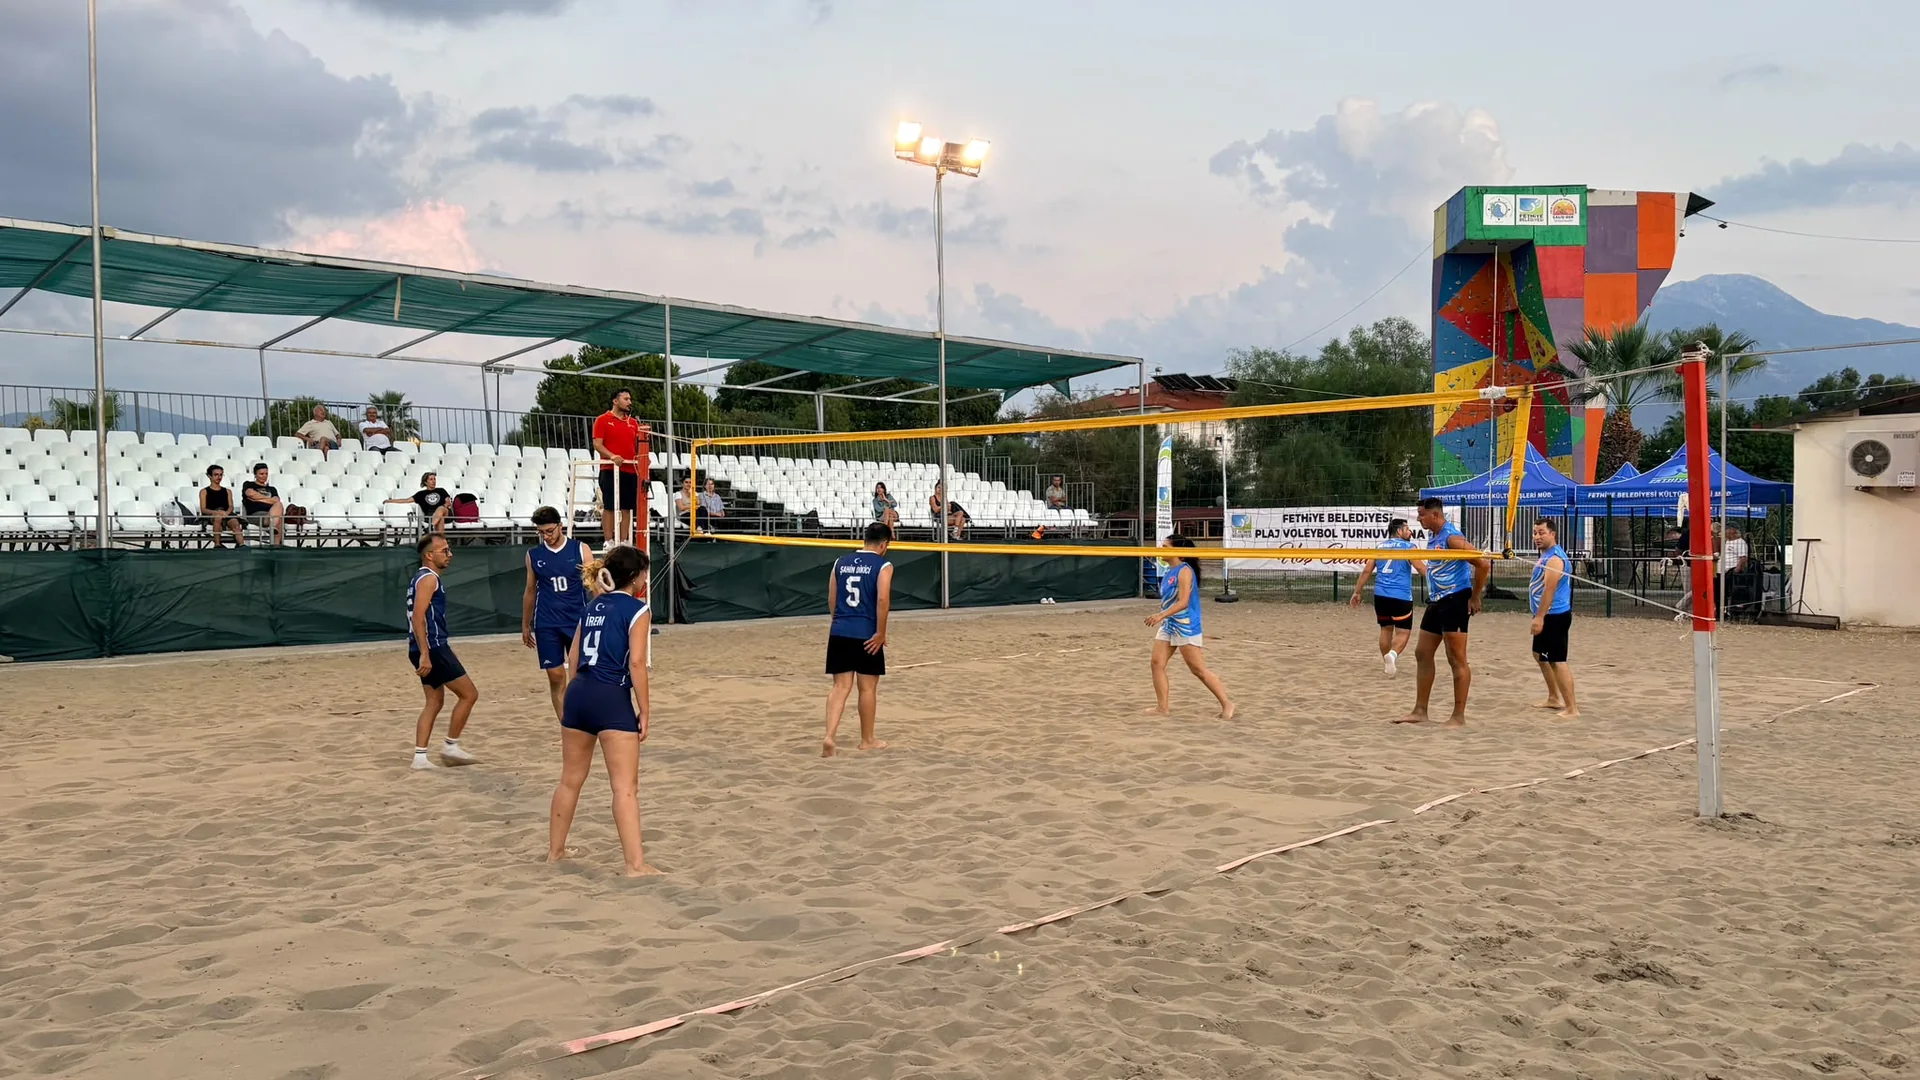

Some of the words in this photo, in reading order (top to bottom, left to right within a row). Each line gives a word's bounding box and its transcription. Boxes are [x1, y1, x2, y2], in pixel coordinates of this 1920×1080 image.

[1255, 529, 1280, 539] PLAJ
[1283, 529, 1338, 538] VOLEYBOL
[1341, 529, 1425, 539] TURNUVNA
[550, 576, 568, 592] 10
[846, 576, 861, 607] 5
[585, 613, 606, 627] İREM
[583, 630, 602, 666] 4
